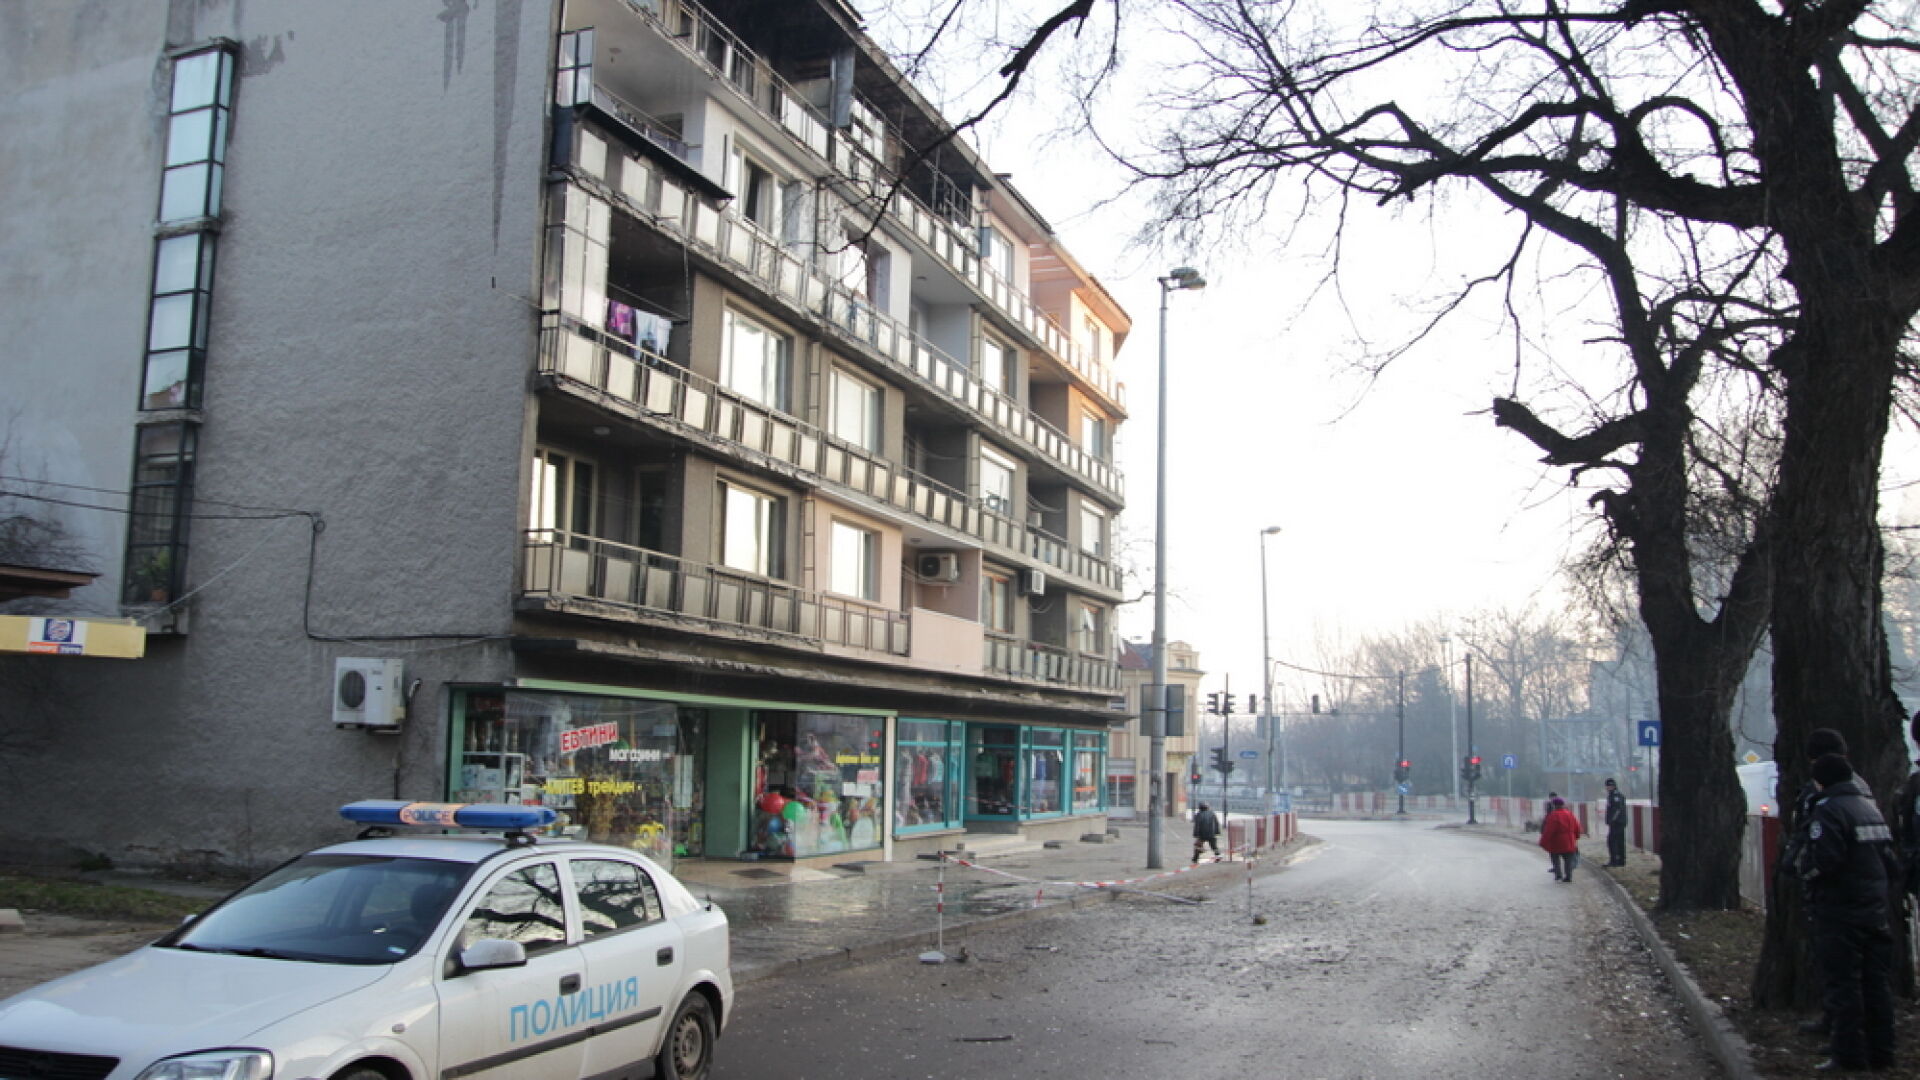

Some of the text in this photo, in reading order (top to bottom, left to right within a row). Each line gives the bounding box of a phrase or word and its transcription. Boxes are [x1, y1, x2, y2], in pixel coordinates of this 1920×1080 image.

[561, 722, 618, 753] ЕВТИНИ
[402, 808, 451, 823] POLICE
[510, 975, 638, 1042] ПОЛИЦИЯ
